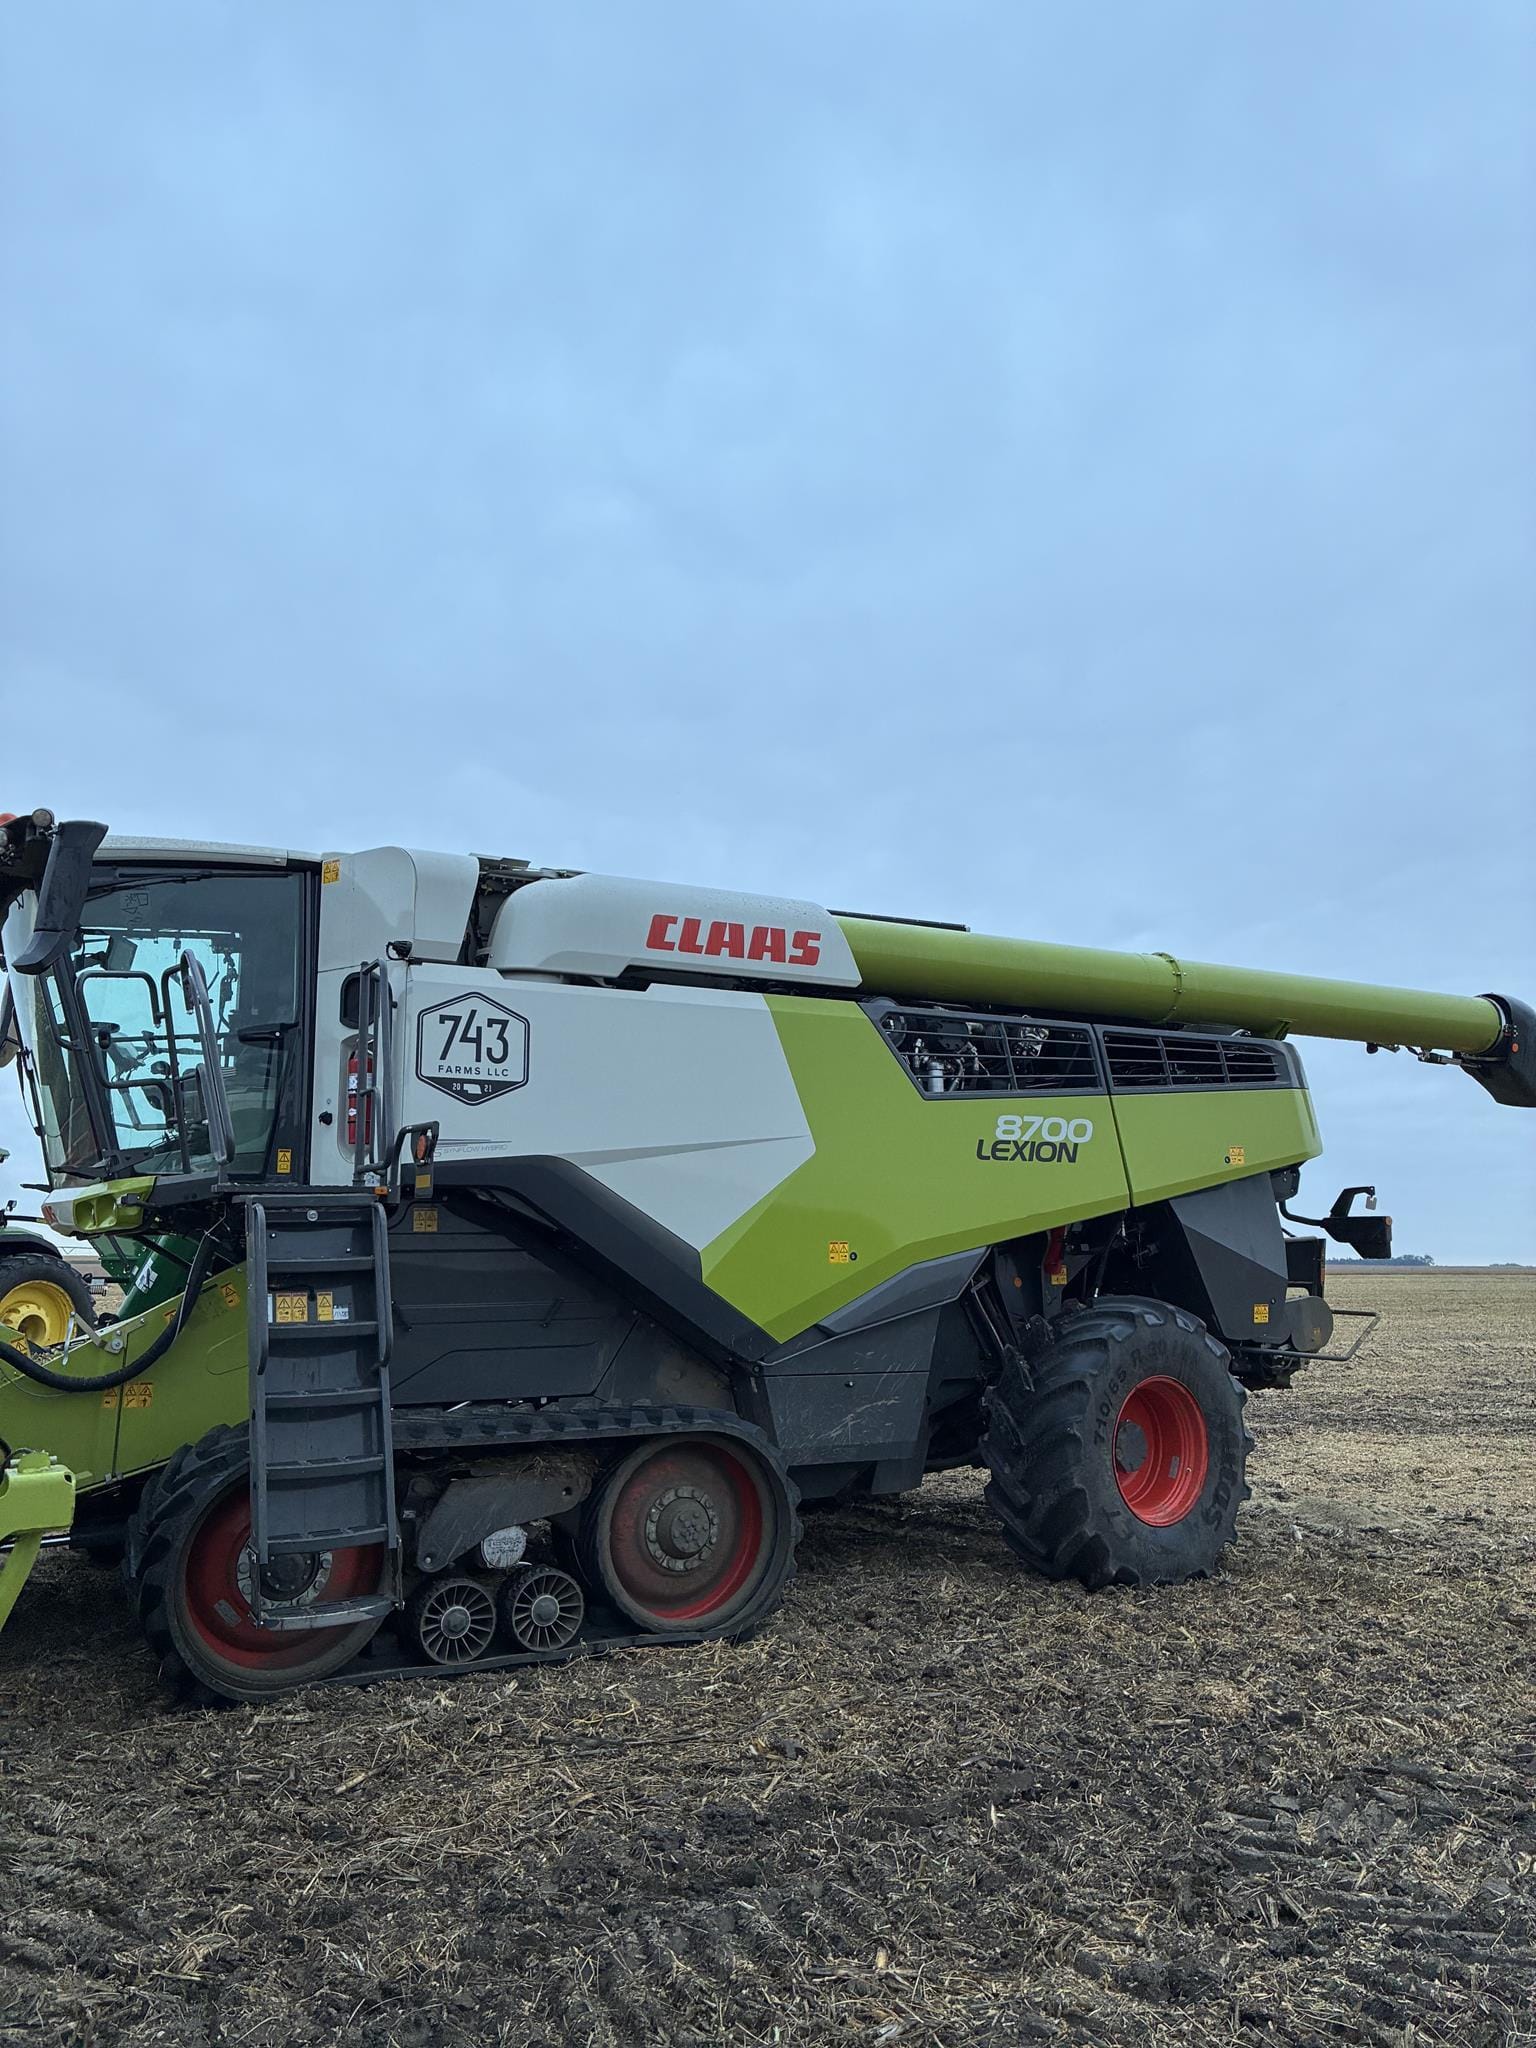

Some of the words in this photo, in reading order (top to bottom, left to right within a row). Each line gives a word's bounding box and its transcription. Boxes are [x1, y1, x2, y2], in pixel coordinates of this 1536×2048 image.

[646, 914, 821, 966] CLAAS
[439, 1009, 510, 1064] 743
[438, 1065, 481, 1075] FARMS
[487, 1067, 509, 1077] LLC
[452, 1082, 461, 1091] 20
[484, 1084, 492, 1093] 21
[995, 1115, 1093, 1143] 8700
[977, 1139, 1078, 1163] LEXION
